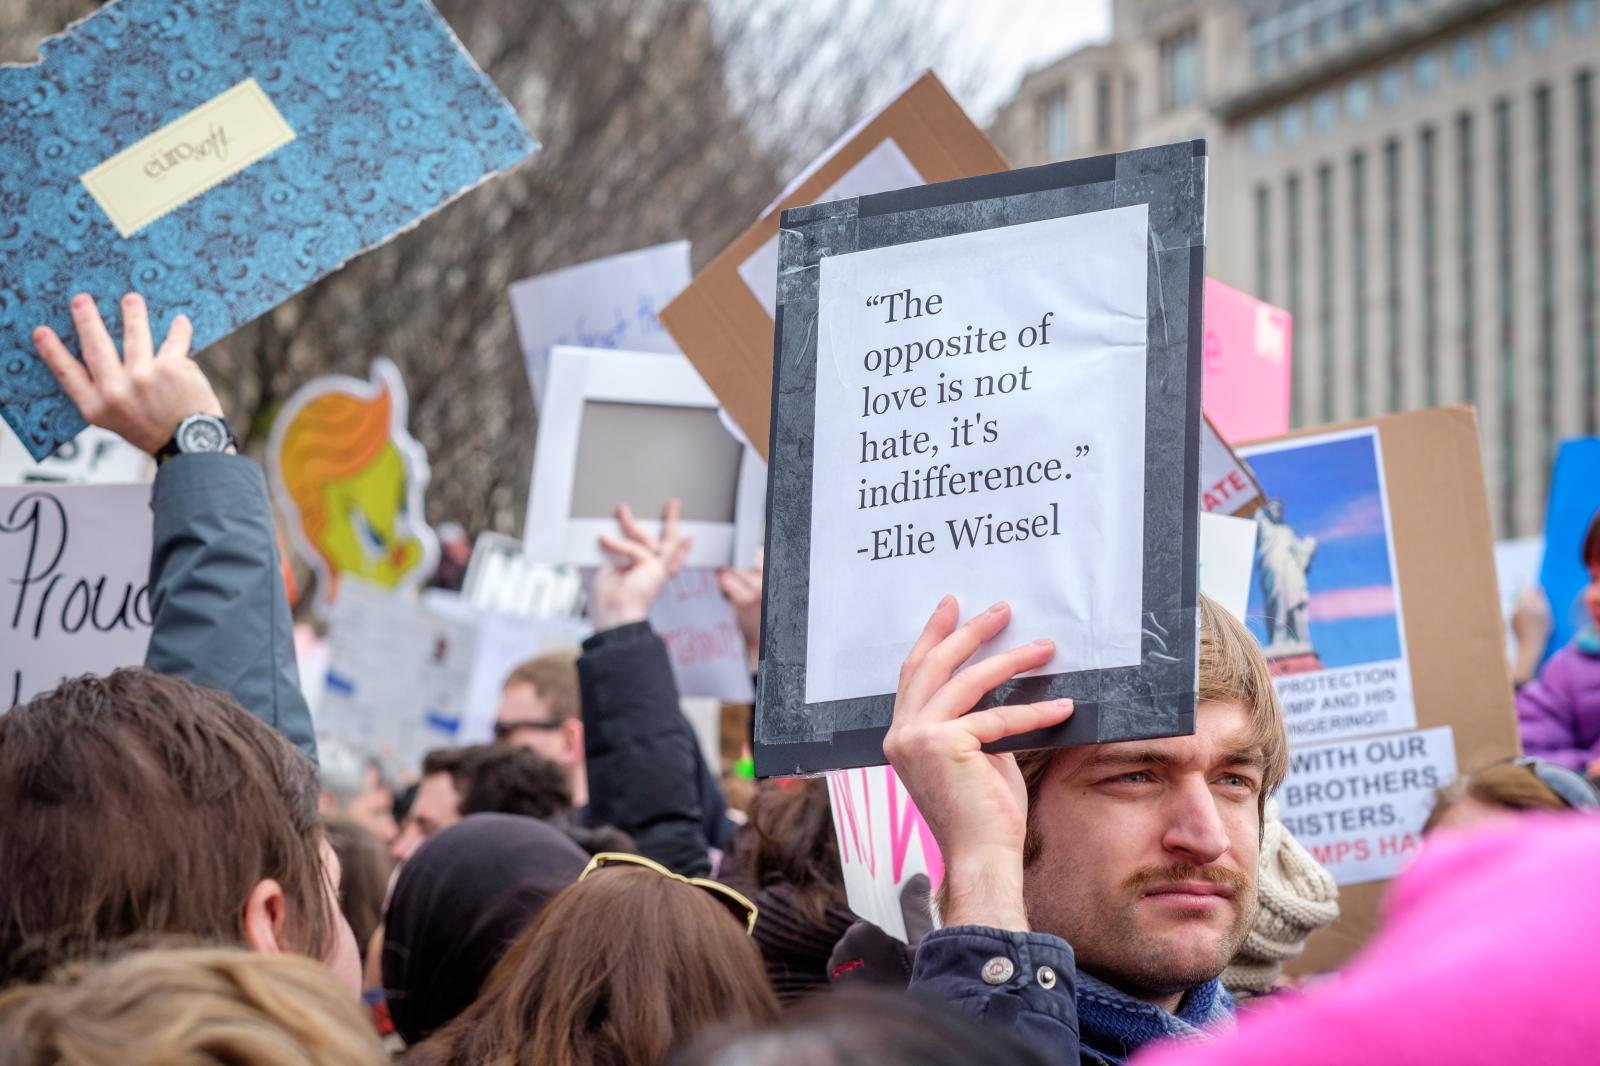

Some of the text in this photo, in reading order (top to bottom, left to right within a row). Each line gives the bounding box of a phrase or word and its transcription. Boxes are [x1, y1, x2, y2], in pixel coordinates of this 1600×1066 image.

[866, 289, 943, 324] “The
[863, 311, 1054, 377] opposite of
[861, 366, 1032, 417] love is not
[859, 412, 998, 463] hate, it's
[858, 445, 1090, 509] indifference.”
[1202, 469, 1247, 511] ATE
[857, 502, 1061, 561] -Elie Wiesel
[1278, 667, 1397, 694] PROTECTION
[1285, 687, 1396, 715] MP AND HIS
[1287, 709, 1388, 735] NGERING!!
[1290, 736, 1427, 774] WITH OUR
[1285, 766, 1439, 808] BROTHERS
[1308, 832, 1420, 865] MPS HA
